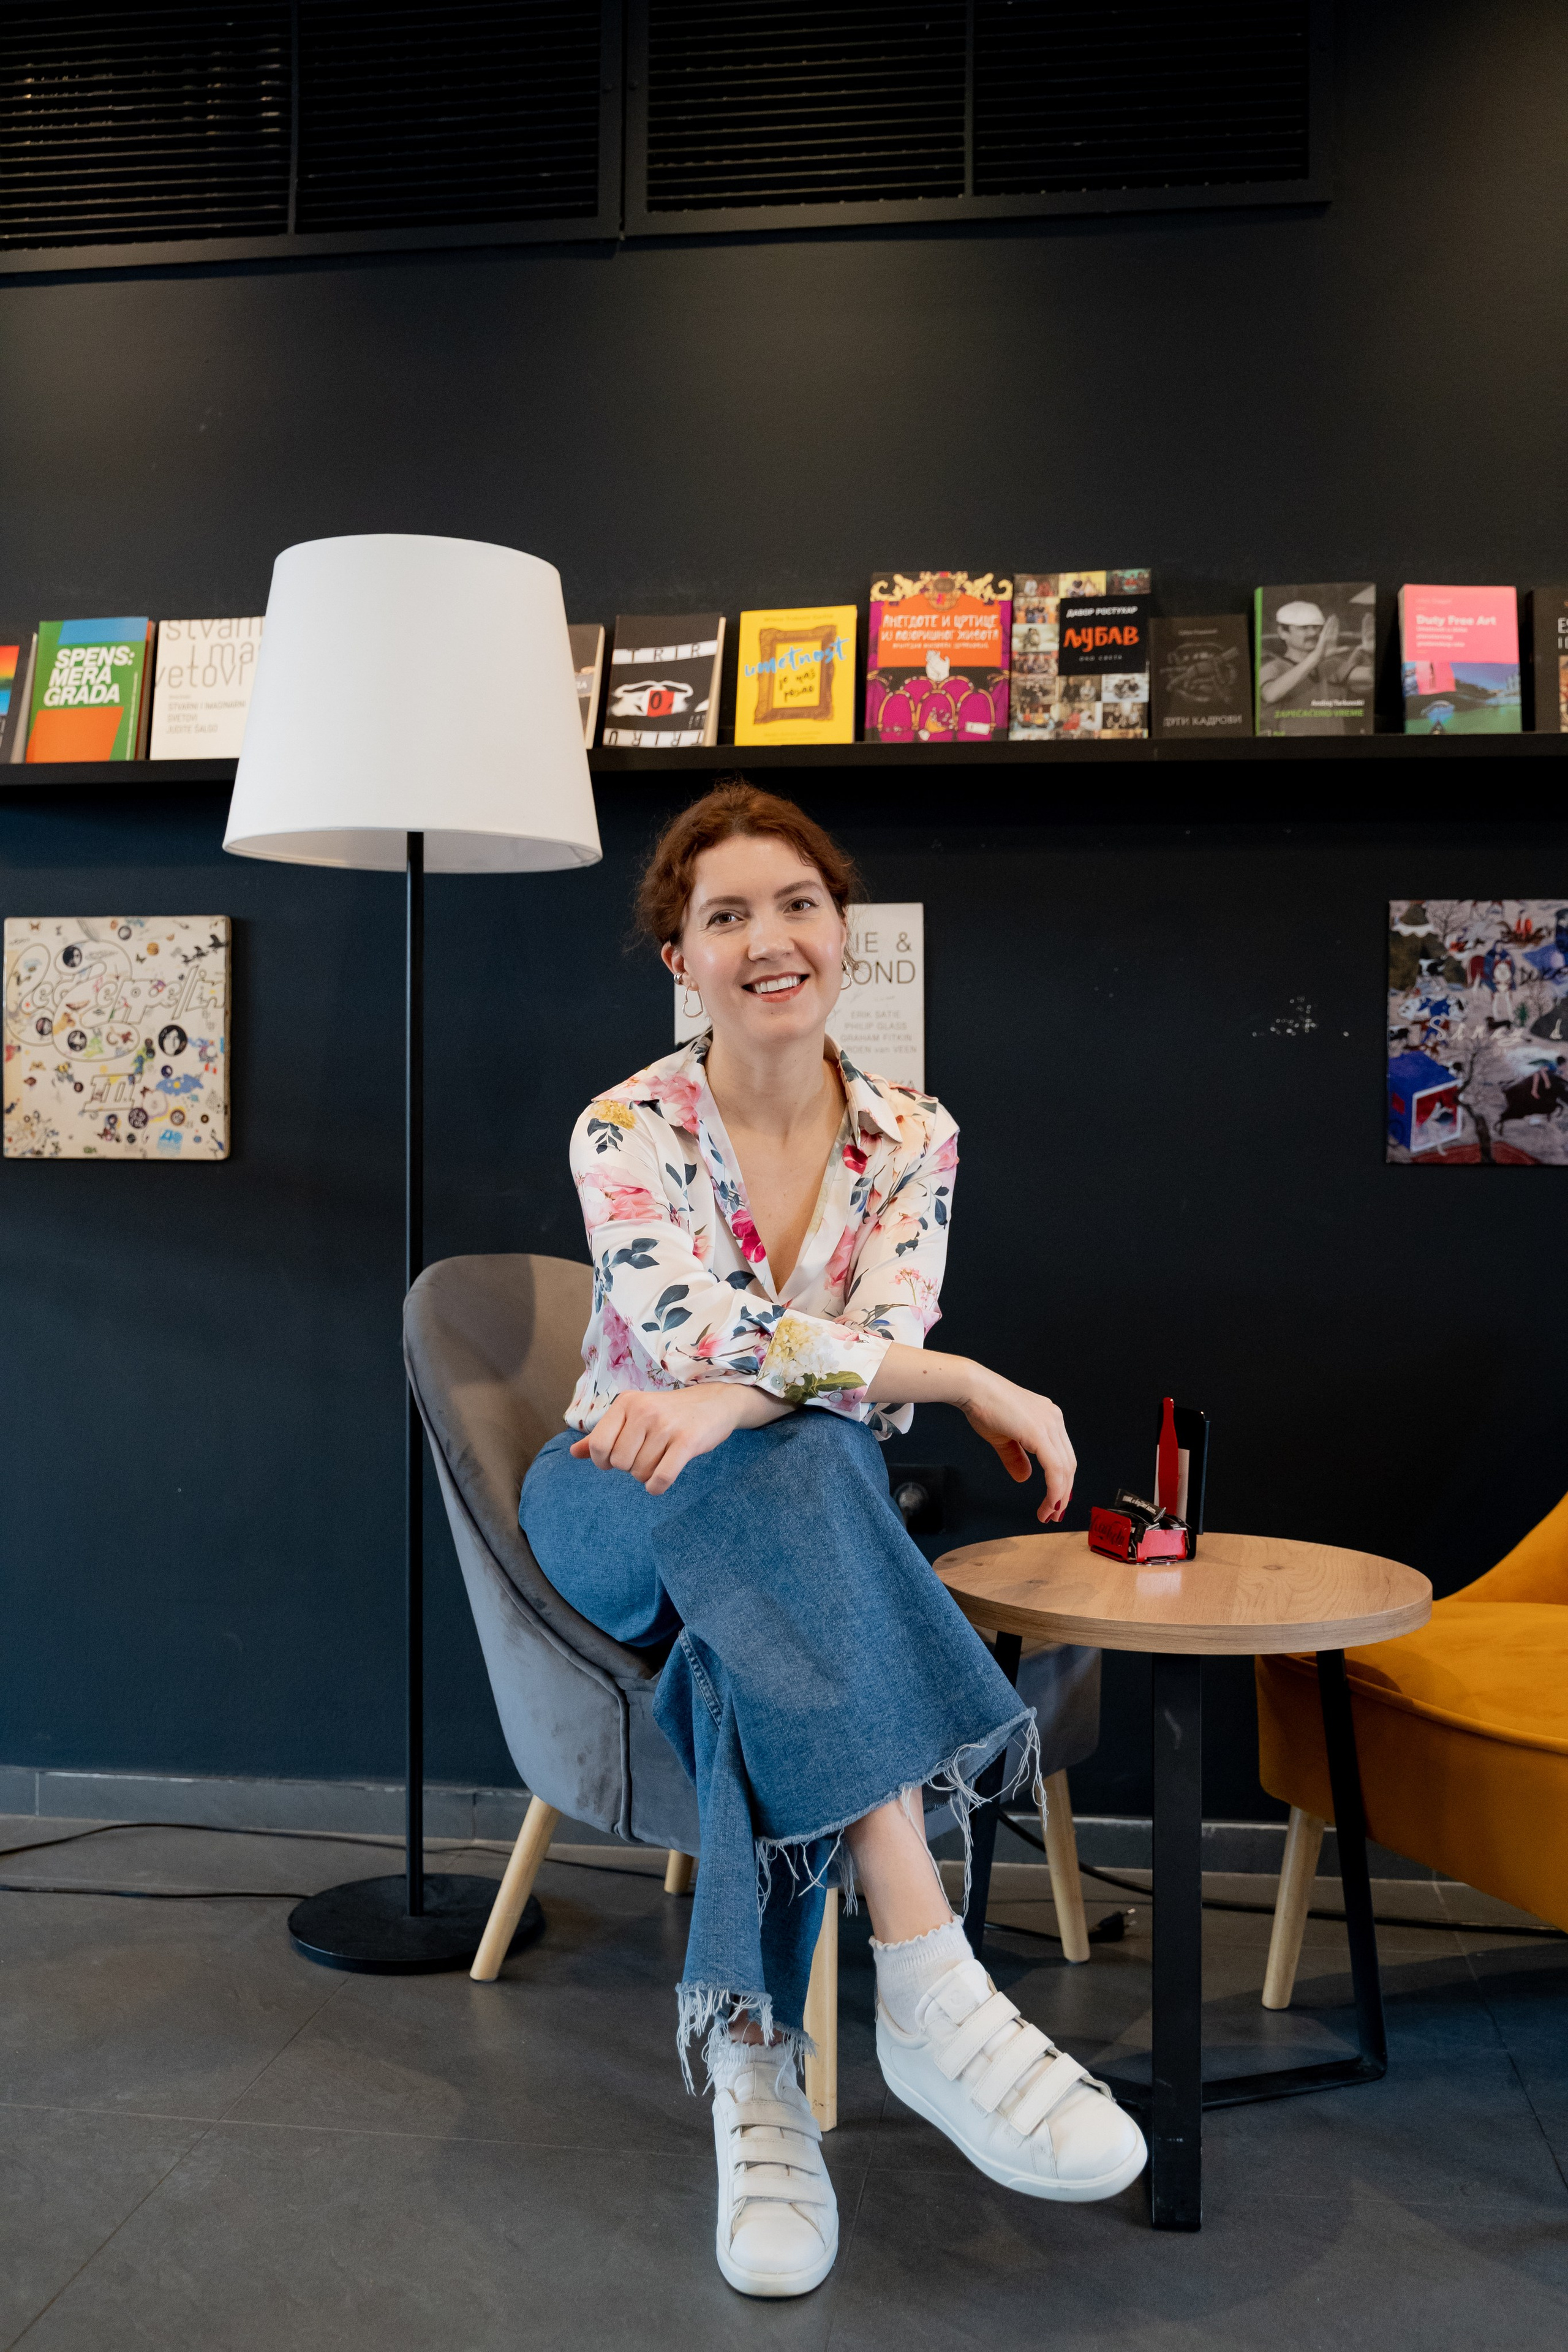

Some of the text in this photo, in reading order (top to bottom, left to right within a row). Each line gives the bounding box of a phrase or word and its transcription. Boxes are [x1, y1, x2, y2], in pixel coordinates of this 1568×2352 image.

[1416, 615, 1496, 627] Duty Free Art
[55, 646, 135, 669] SPENS:
[745, 636, 850, 677] umetnost
[48, 666, 112, 688] MERA
[43, 684, 121, 706] GRADA
[875, 1010, 900, 1019] SATIE
[876, 1022, 908, 1030] GLASS
